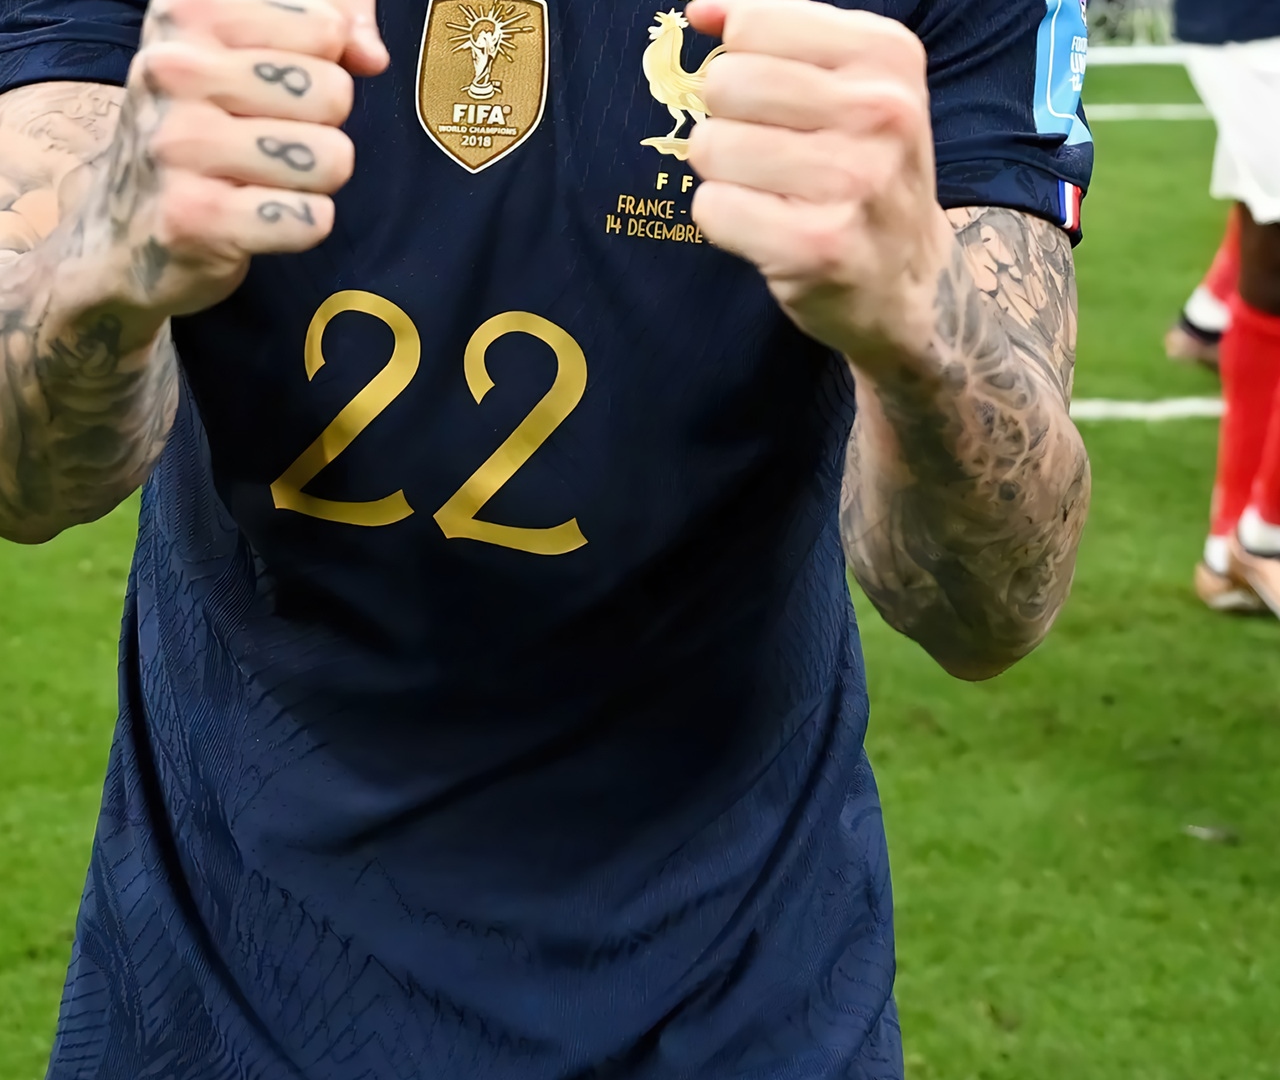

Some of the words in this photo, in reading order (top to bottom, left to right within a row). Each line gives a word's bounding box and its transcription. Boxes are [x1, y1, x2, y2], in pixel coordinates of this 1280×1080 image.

[452, 103, 506, 125] FIFA
[438, 125, 467, 134] WORLD
[469, 126, 517, 136] CHAMPIONS
[461, 135, 492, 147] 2018
[617, 194, 675, 219] FRANCE
[605, 214, 622, 234] 14
[627, 218, 703, 244] DECEMBRE
[270, 289, 589, 555] 22
